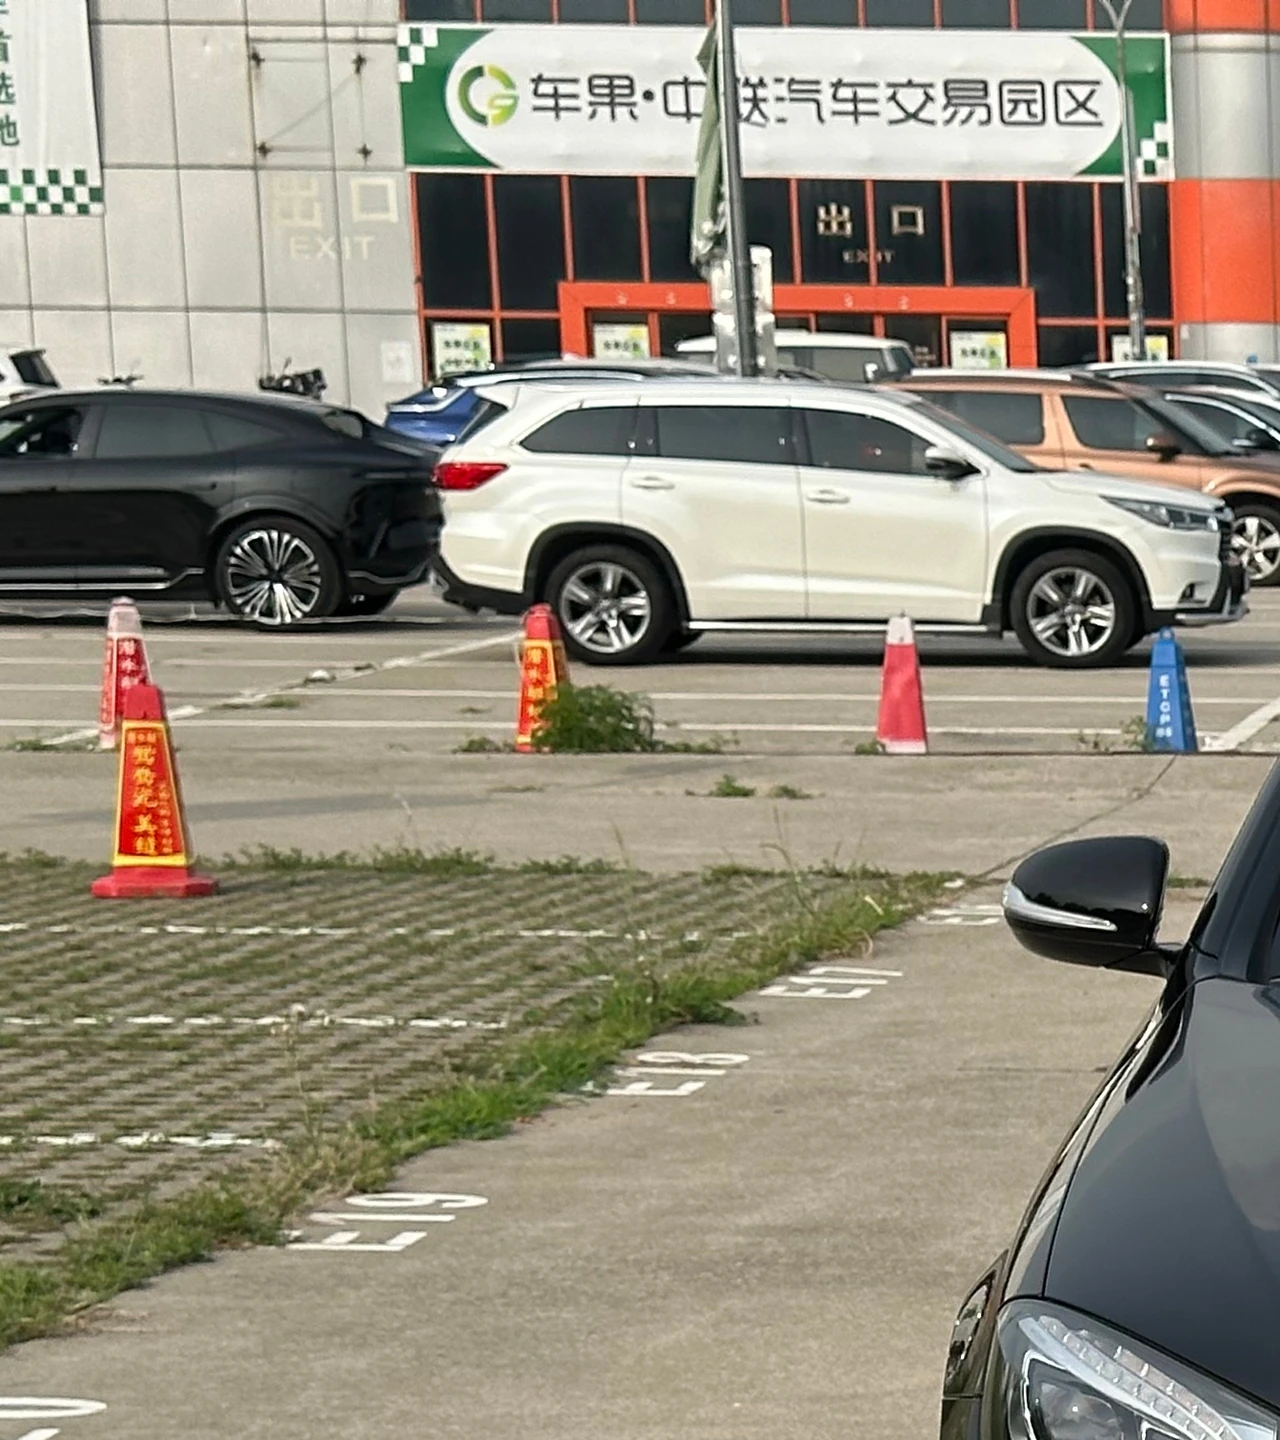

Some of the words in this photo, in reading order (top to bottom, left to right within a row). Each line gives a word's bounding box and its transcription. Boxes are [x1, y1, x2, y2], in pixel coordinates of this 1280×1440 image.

[817, 202, 925, 237] 出口
[290, 235, 375, 261] EXIT
[758, 966, 903, 998] E17
[580, 1051, 750, 1096] E18
[284, 1192, 489, 1251] E19
